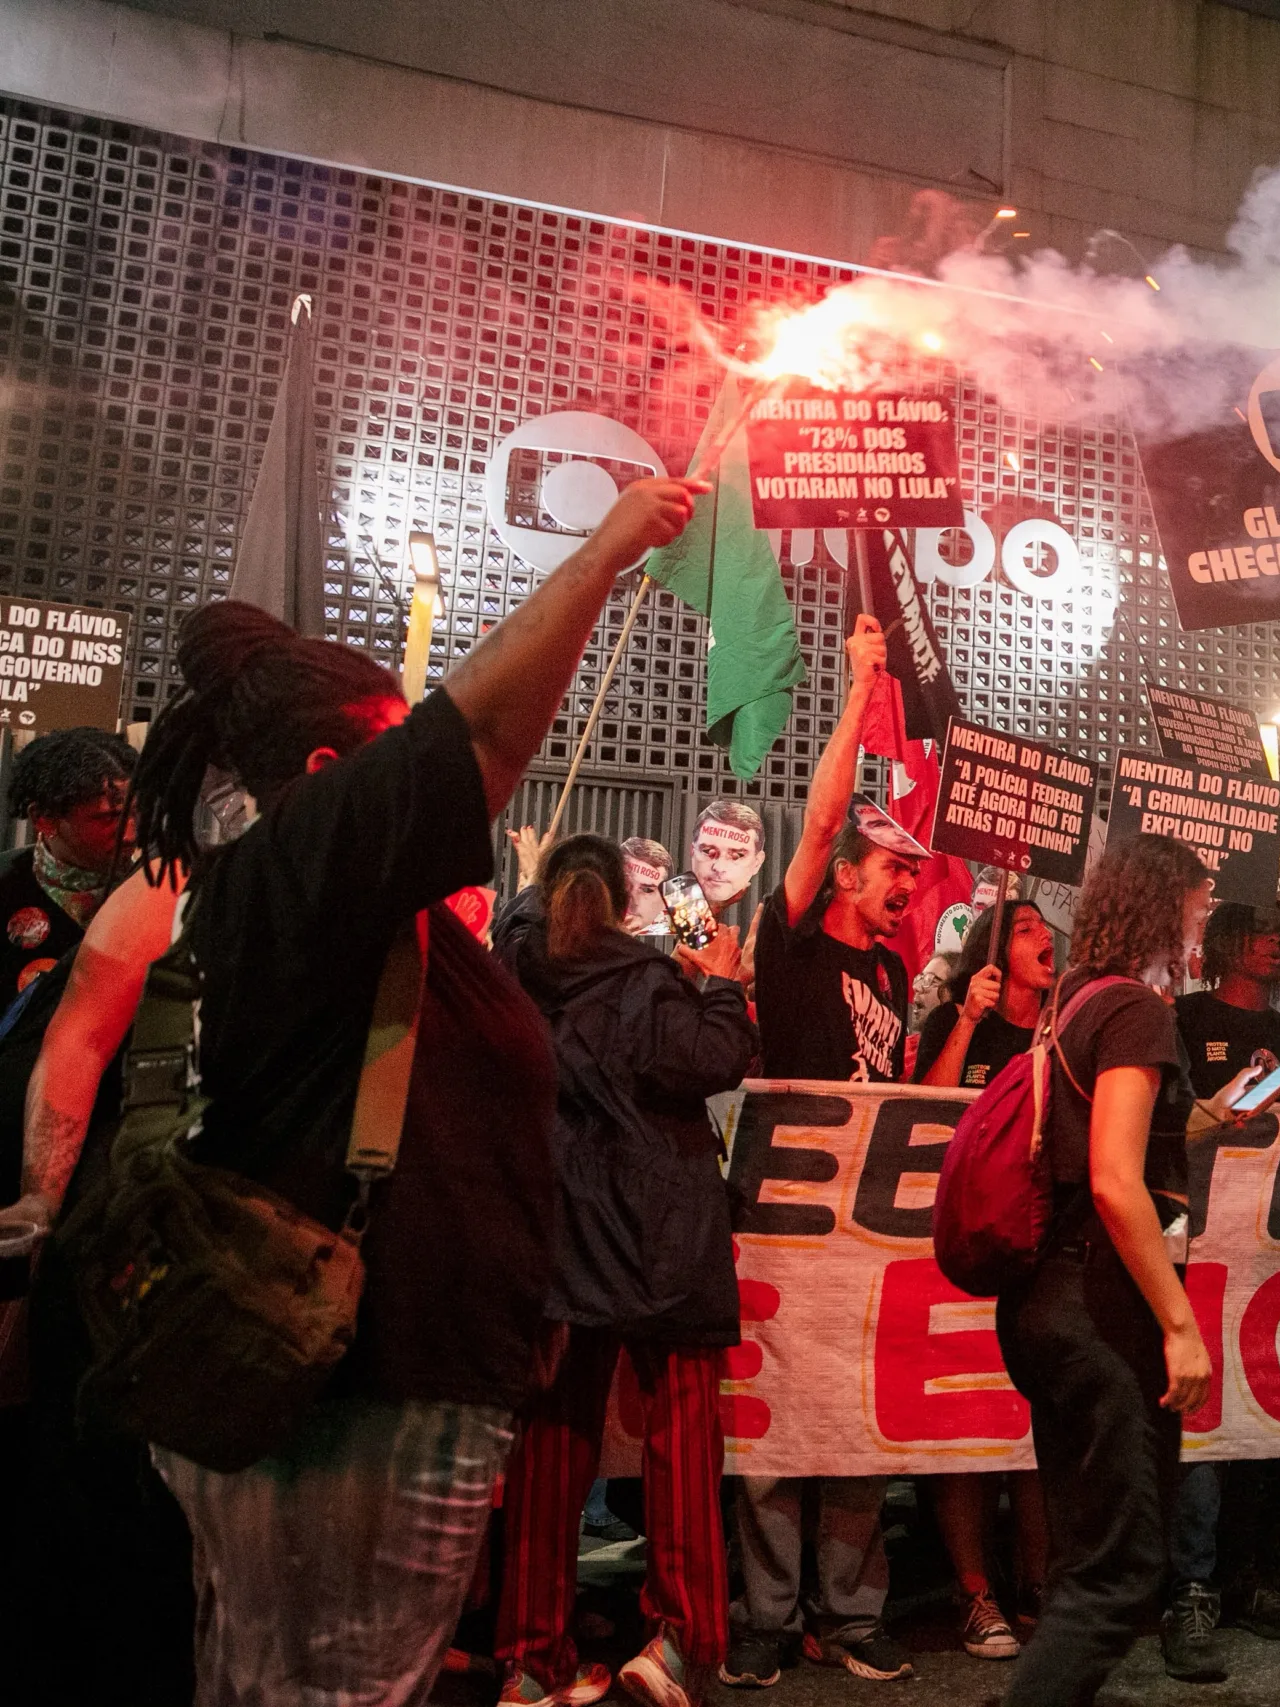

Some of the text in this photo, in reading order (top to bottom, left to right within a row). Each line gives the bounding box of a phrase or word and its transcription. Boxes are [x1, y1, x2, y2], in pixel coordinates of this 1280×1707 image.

[750, 398, 838, 421] MENTIRA
[843, 400, 872, 421] DO
[863, 427, 907, 450] DOS
[784, 449, 926, 475] PRESIDIÁRIOS
[756, 477, 858, 499] VOTARAM
[864, 477, 893, 499] NO
[8, 605, 122, 639] DO FLÁVIO:
[32, 634, 65, 658] DO
[70, 639, 122, 665] INSS
[1149, 688, 1199, 713] MENTIRA
[1200, 701, 1217, 718] DO
[1158, 716, 1193, 733] GOVERNO
[1163, 728, 1174, 740] DE
[1221, 721, 1236, 734] ANO
[1237, 726, 1247, 737] DE
[951, 725, 1016, 764] MENTIRA
[1019, 746, 1041, 771] DO
[1044, 756, 1094, 788] FLÁVIO:
[1182, 743, 1252, 769] AO ARMAMENTO DA
[975, 765, 1028, 797] POLÍCIA
[1031, 781, 1084, 814] FEDERAL
[1120, 757, 1194, 790] MENTIRA
[1199, 773, 1223, 795] DO
[945, 803, 993, 833] ATRÁS
[995, 816, 1016, 839] DO
[950, 781, 1082, 835] ATÉ AGORA NÃO FOI
[1147, 789, 1279, 835] CRIMINALIDADE
[1141, 812, 1225, 848] EXPLODIU
[1228, 830, 1254, 853] NO
